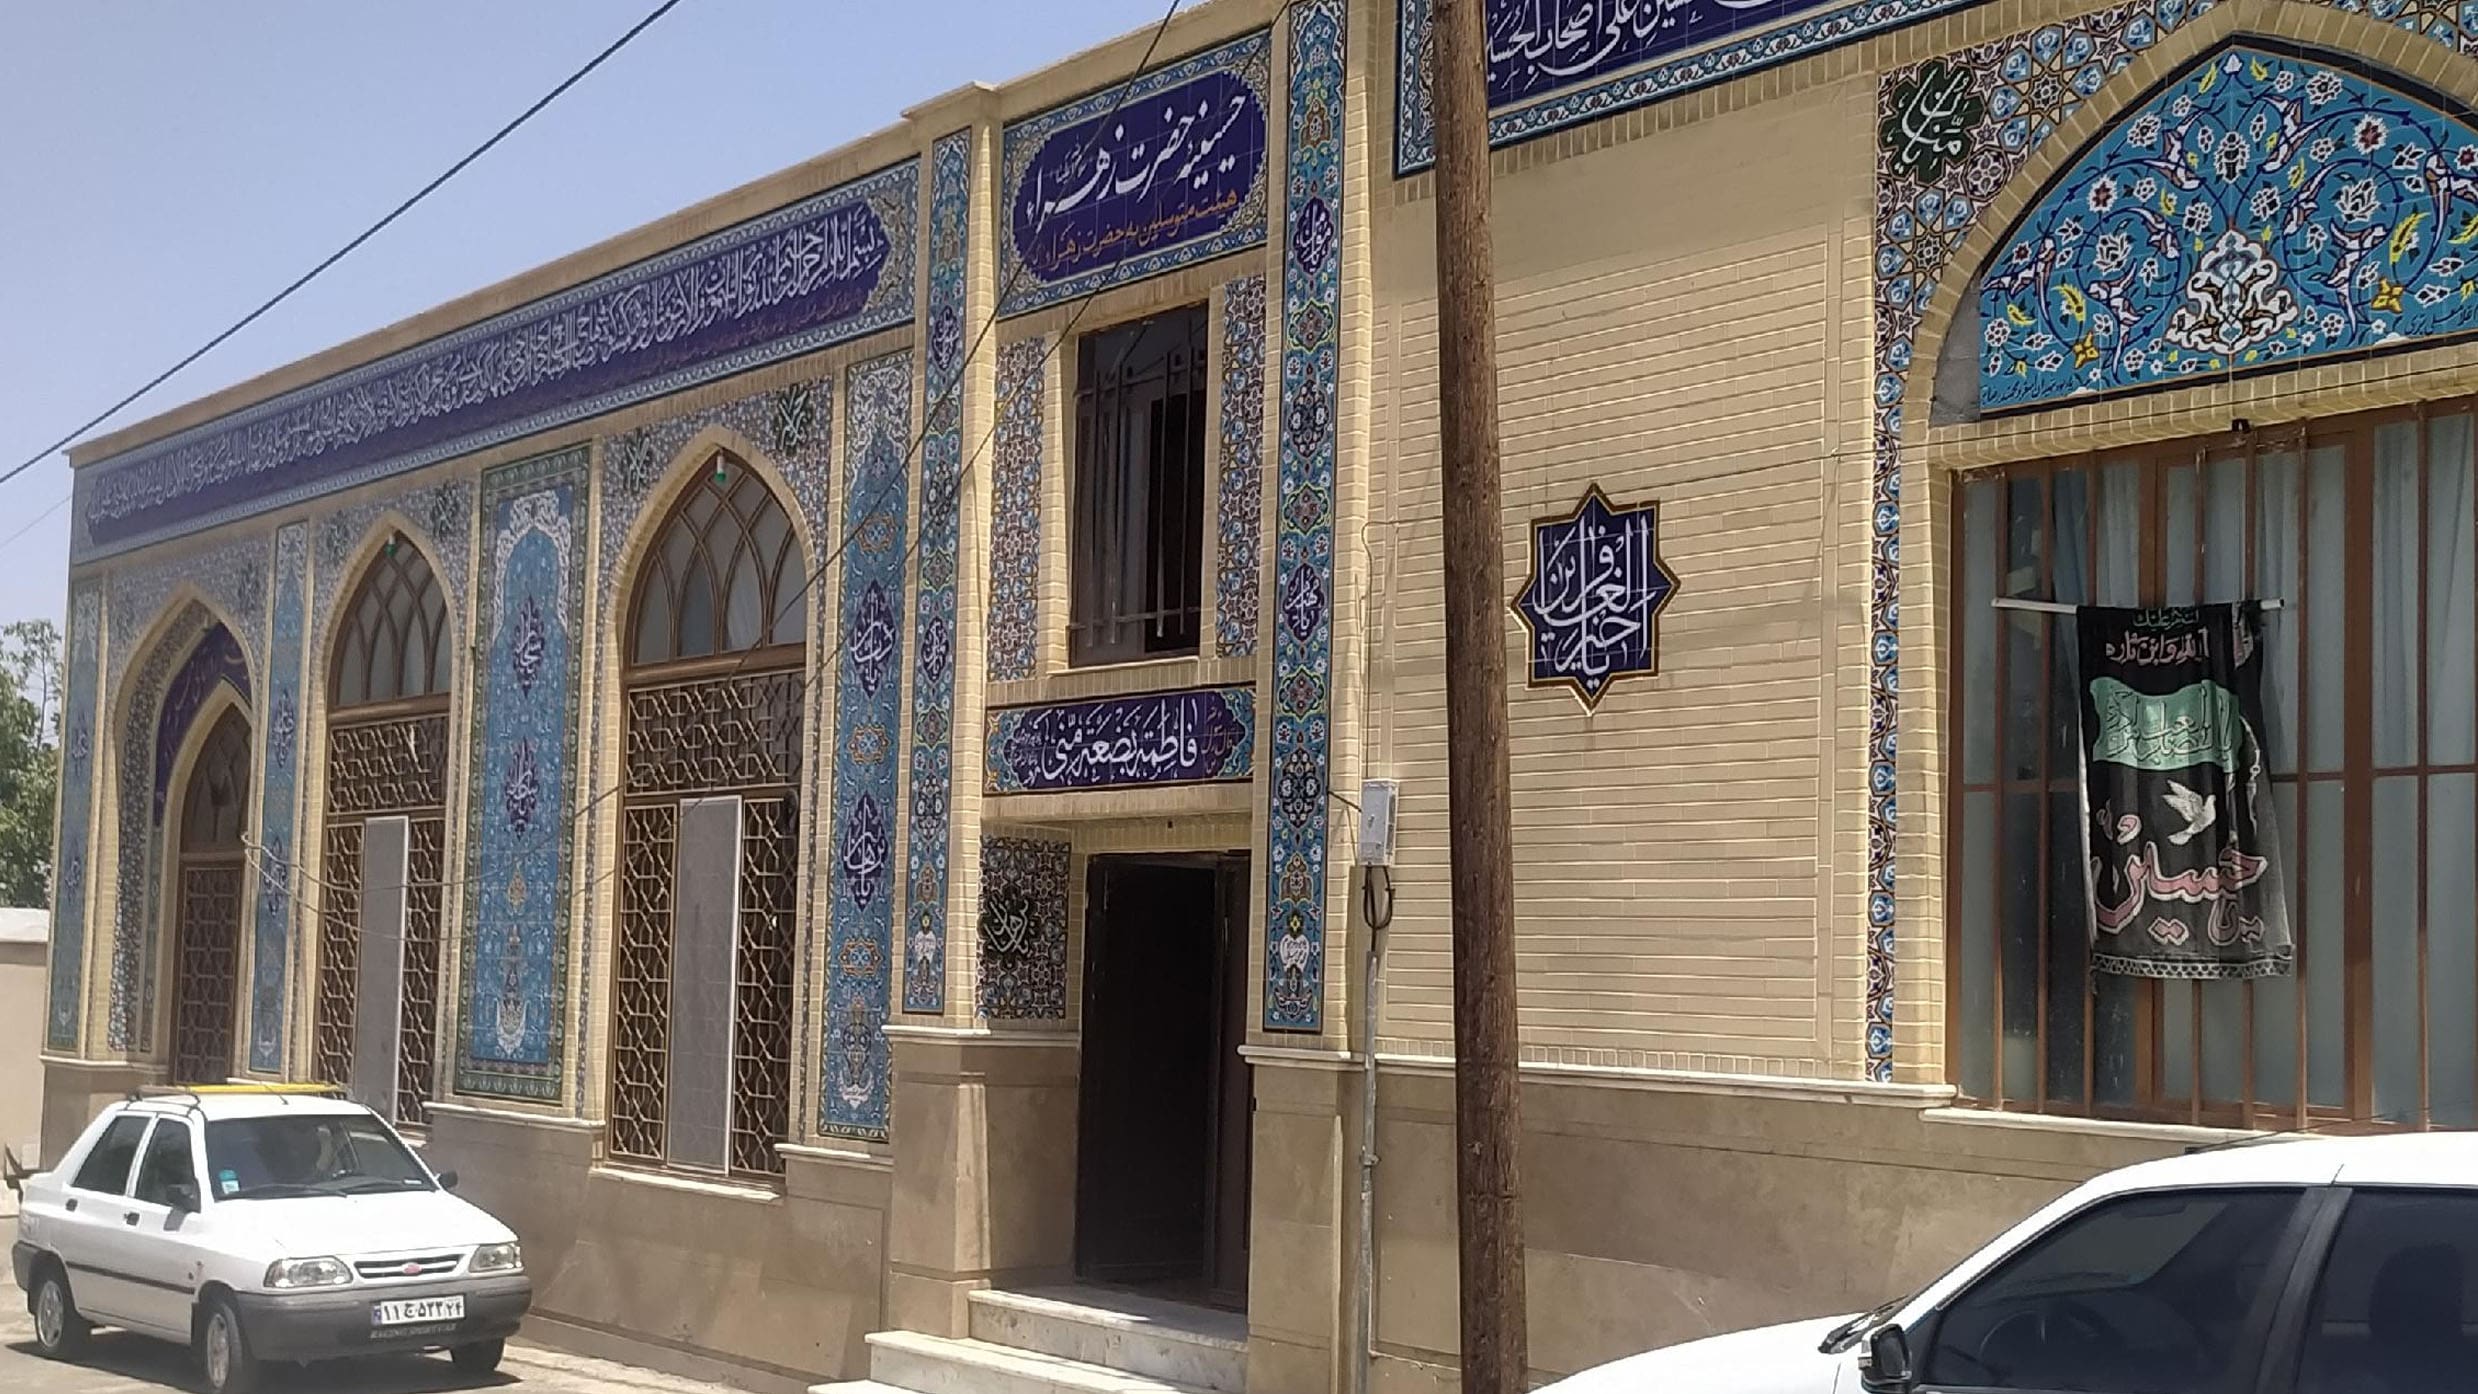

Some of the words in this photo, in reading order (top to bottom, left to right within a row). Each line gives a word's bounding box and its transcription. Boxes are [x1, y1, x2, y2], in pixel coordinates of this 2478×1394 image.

[1113, 105, 1196, 203] حضرت
[1083, 222, 1126, 258] حضرت
[1137, 201, 1196, 247] متوسلین
